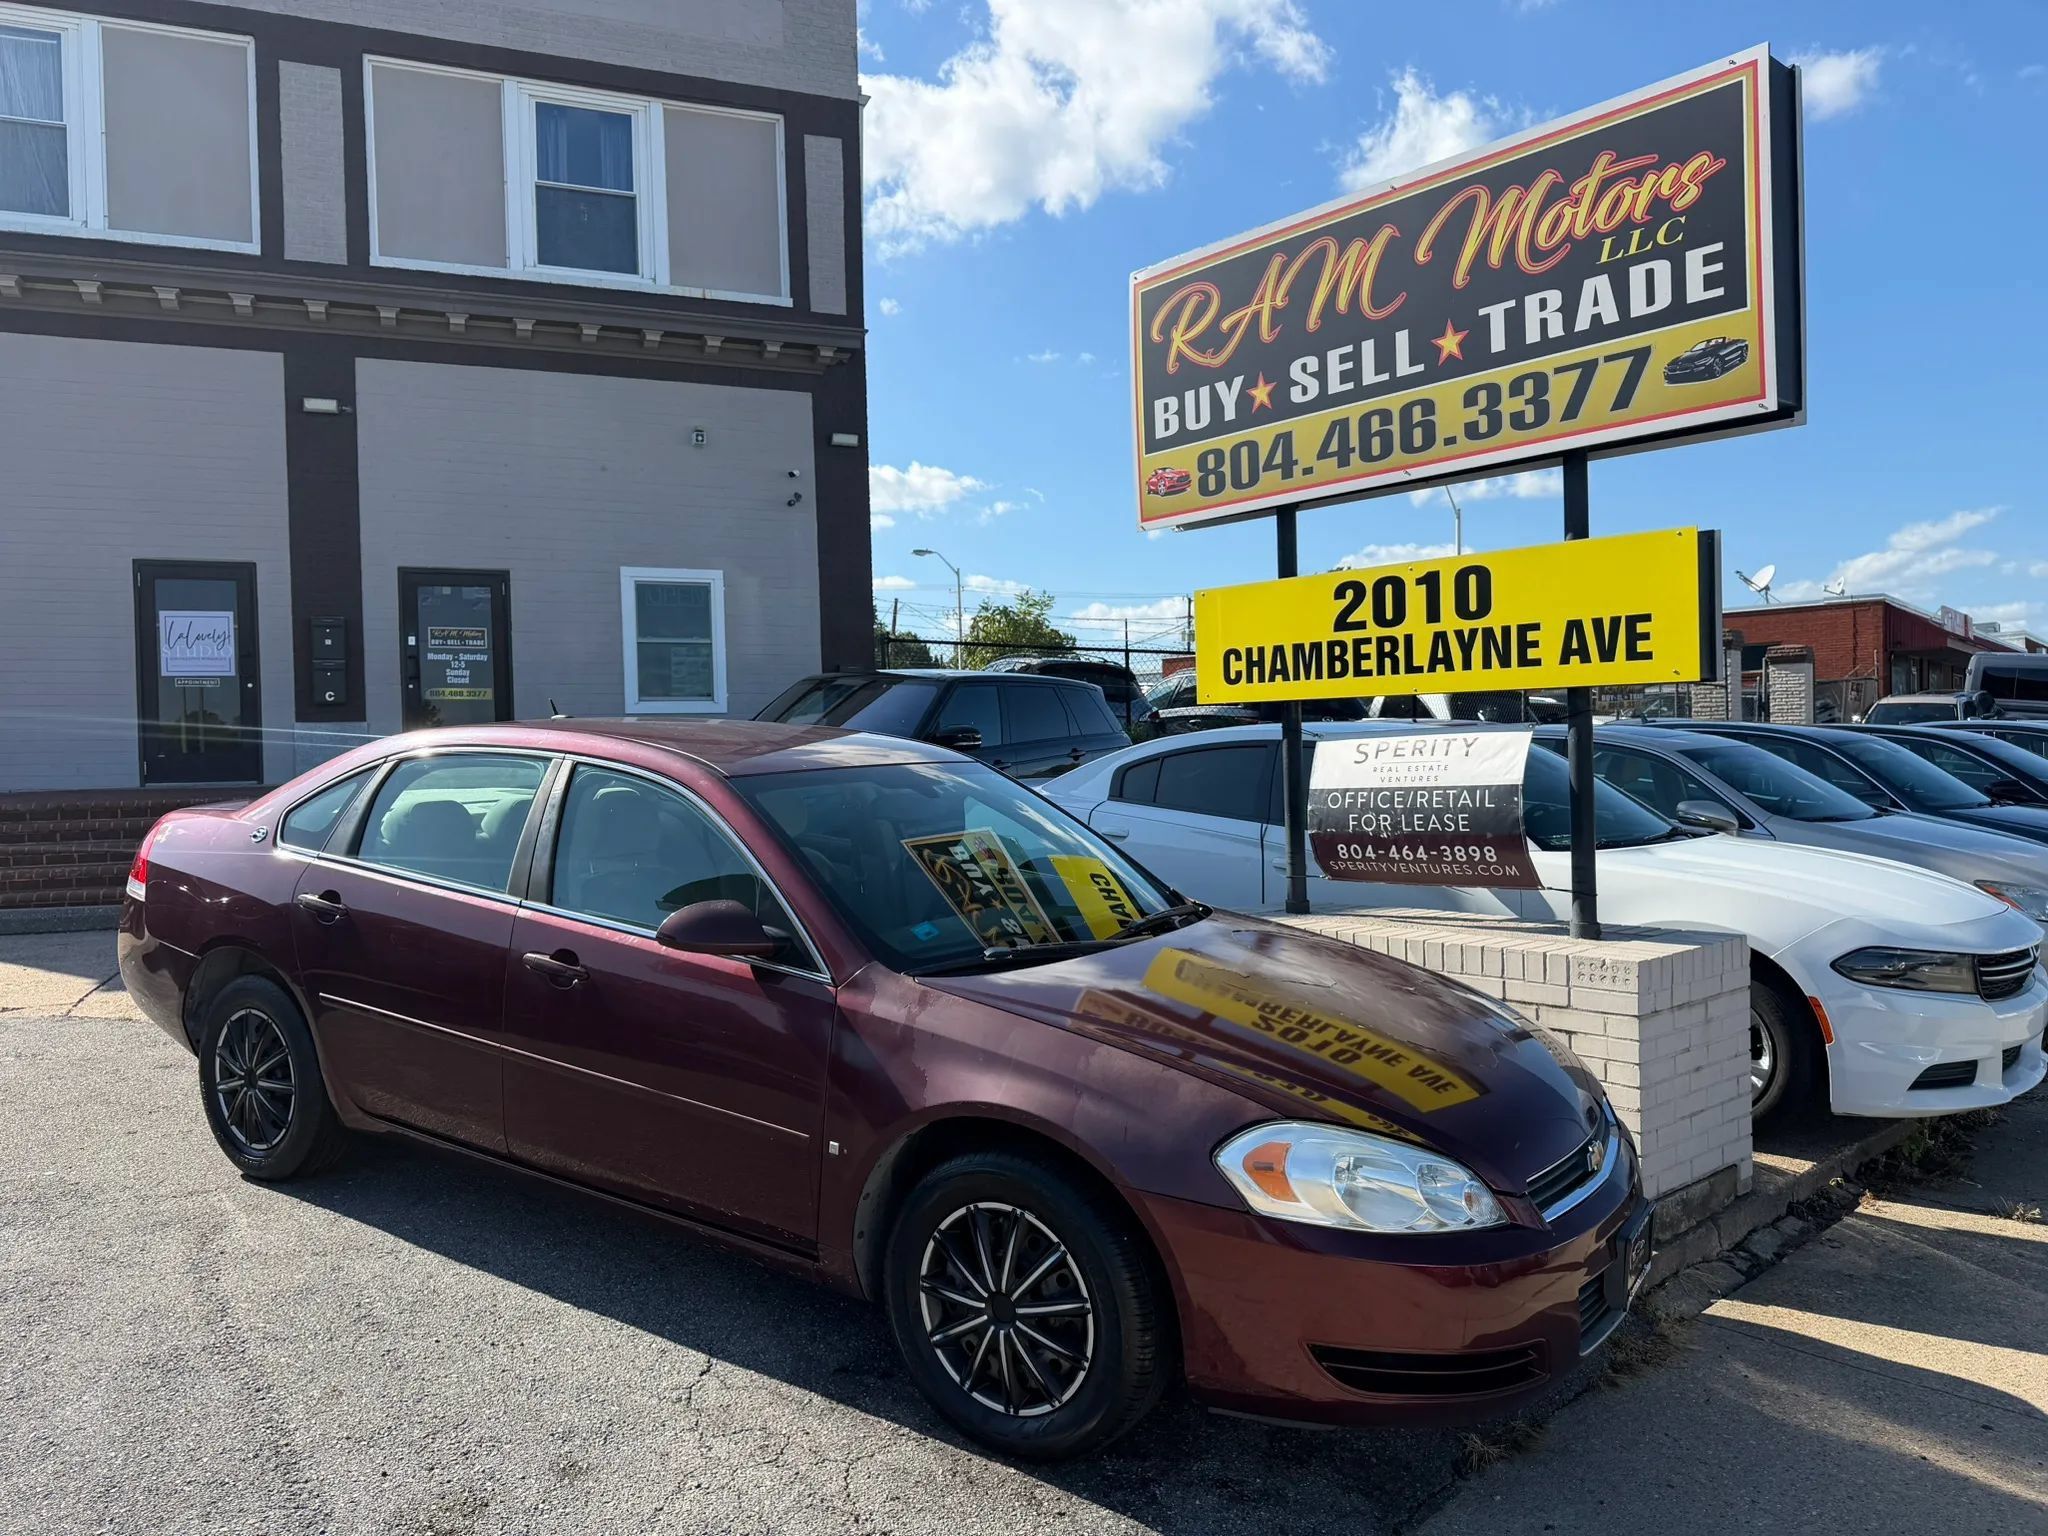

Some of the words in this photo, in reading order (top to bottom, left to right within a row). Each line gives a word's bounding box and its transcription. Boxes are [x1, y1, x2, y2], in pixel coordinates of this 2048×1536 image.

[1596, 215, 1688, 264] LLC
[1151, 223, 1406, 374] RAM
[1414, 150, 1726, 288] Motors
[1154, 375, 1244, 439] BUY
[1289, 329, 1425, 403] SELL
[1478, 241, 1725, 353] TRADE
[1196, 345, 1657, 497] 804.466.3377
[1333, 564, 1492, 633] 2010
[427, 653, 453, 661] Monday
[459, 653, 488, 662] Saturday
[1222, 622, 1541, 686] CHAMBERLAYNE
[1559, 612, 1653, 664] AVE
[446, 669, 470, 677] Sunday
[325, 692, 335, 701] C
[1354, 737, 1480, 764] SPERITY
[1373, 764, 1399, 773] REAL
[1408, 764, 1449, 772] ESTATE
[1380, 775, 1439, 783] VENTURES
[1327, 789, 1496, 809] OFFICE/RETAIL
[1349, 814, 1392, 832] FOR
[1401, 813, 1470, 832] LEASE
[1337, 844, 1498, 862] 804-464-3898
[1329, 860, 1520, 877] SPERITYVENTURES.COM
